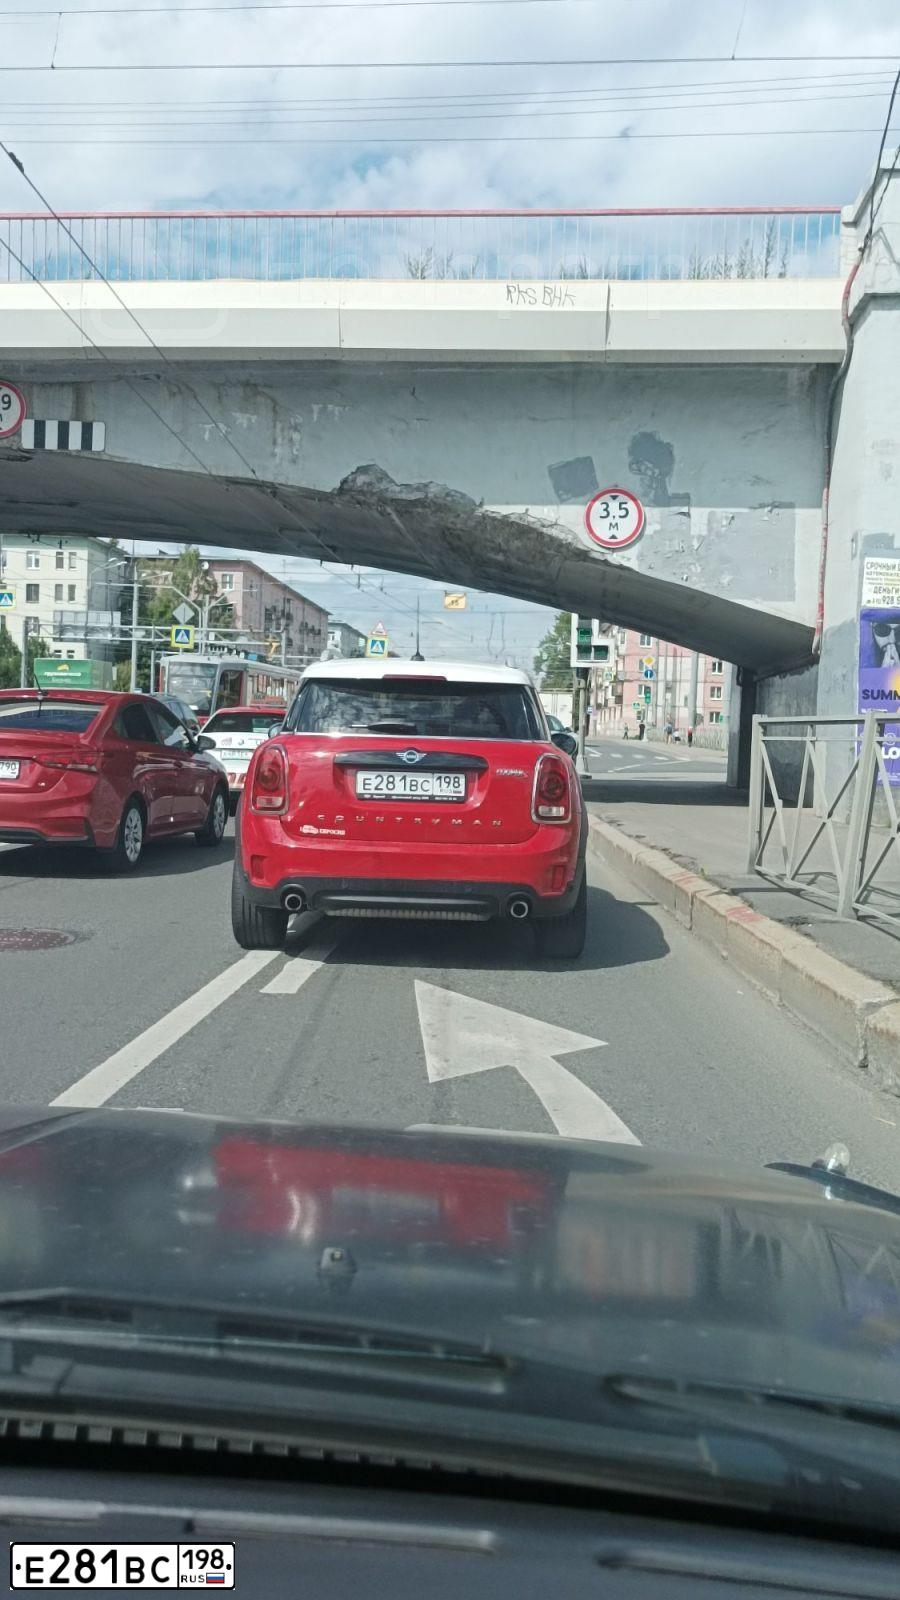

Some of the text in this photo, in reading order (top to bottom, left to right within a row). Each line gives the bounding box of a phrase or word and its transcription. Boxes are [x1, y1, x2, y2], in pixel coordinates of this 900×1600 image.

[866, 561, 896, 572] СРОЧНЫЙ
[873, 586, 900, 595] ДЕНЬГИ
[363, 774, 461, 792] Е281ВС 198
